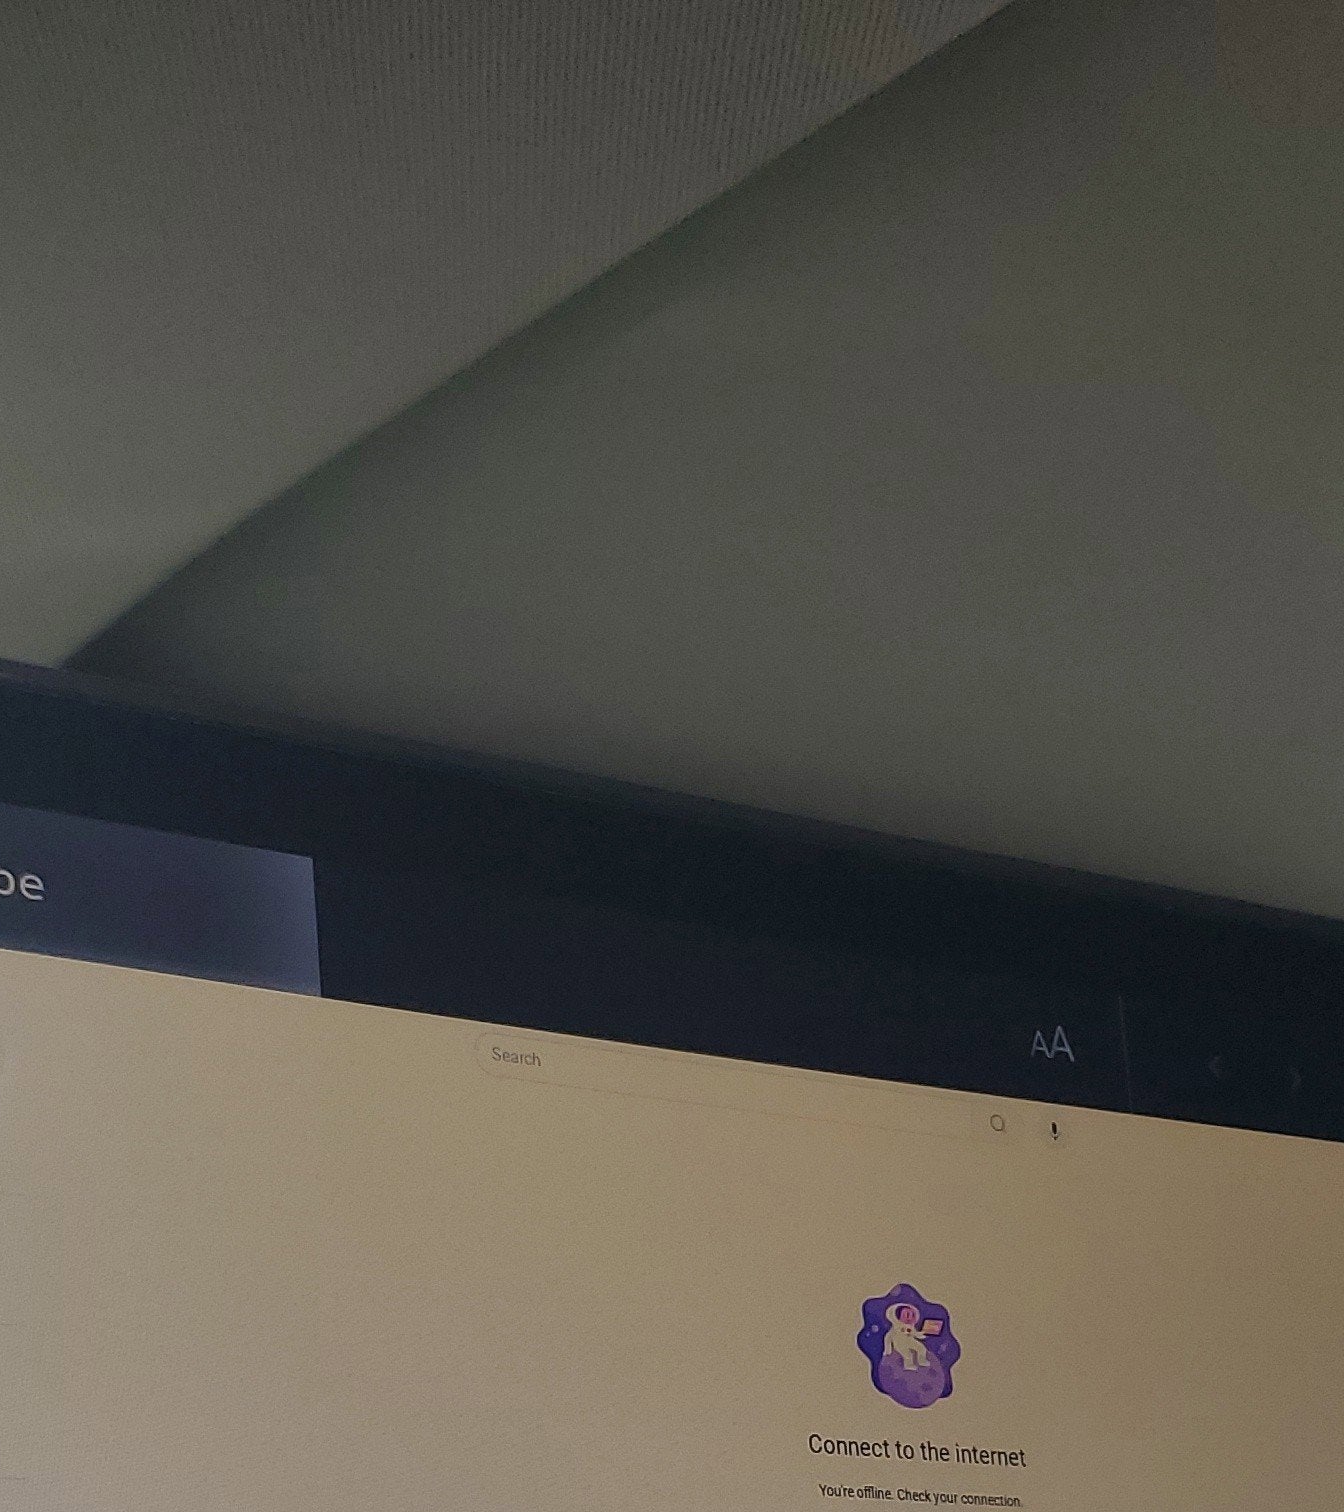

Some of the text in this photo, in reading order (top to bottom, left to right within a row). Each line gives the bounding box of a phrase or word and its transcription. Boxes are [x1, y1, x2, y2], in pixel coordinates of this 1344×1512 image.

[492, 1046, 541, 1067] Search
[808, 1433, 1027, 1468] Connect to the internet
[818, 1483, 855, 1498] You're
[897, 1488, 931, 1502] Check
[933, 1492, 958, 1505] your
[961, 1493, 1023, 1508] connection.
